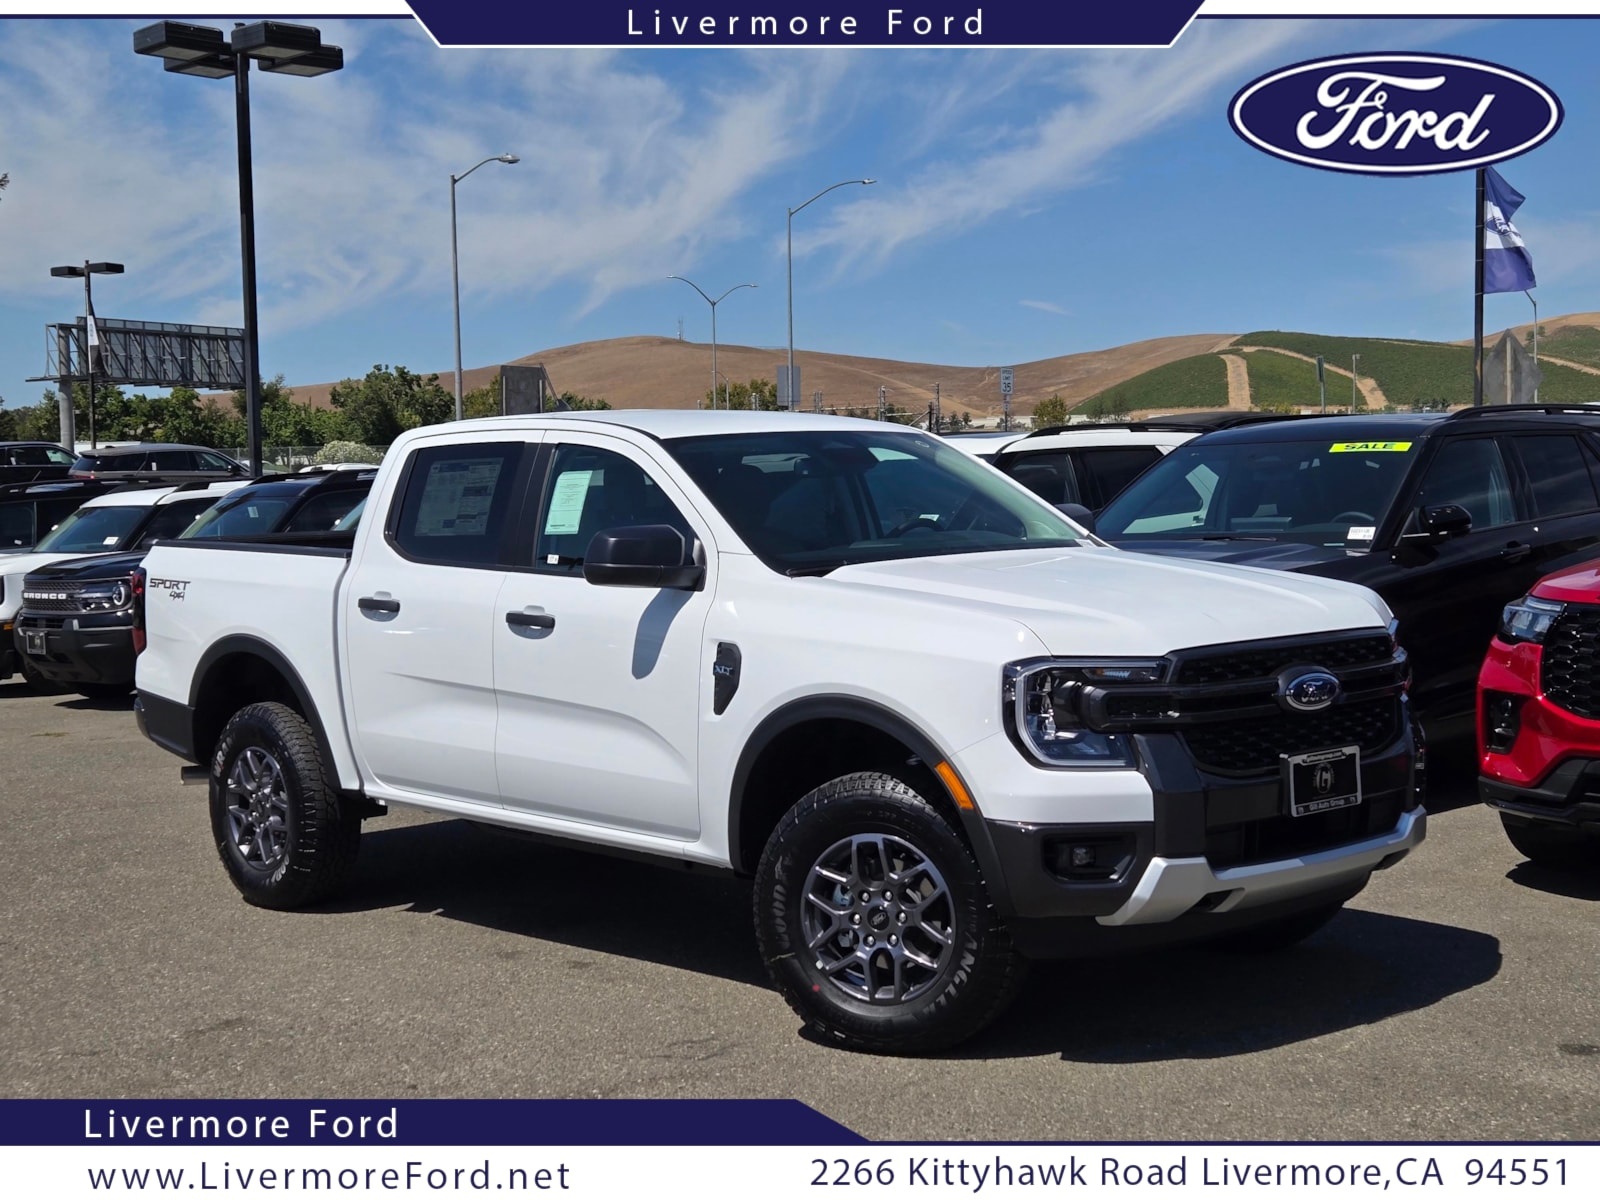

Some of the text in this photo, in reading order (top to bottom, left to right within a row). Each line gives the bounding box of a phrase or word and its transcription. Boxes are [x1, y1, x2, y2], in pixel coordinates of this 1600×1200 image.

[1002, 382, 1012, 393] 35
[149, 578, 191, 591] SPORT
[23, 592, 67, 600] BRONCO
[715, 665, 733, 675] XLT
